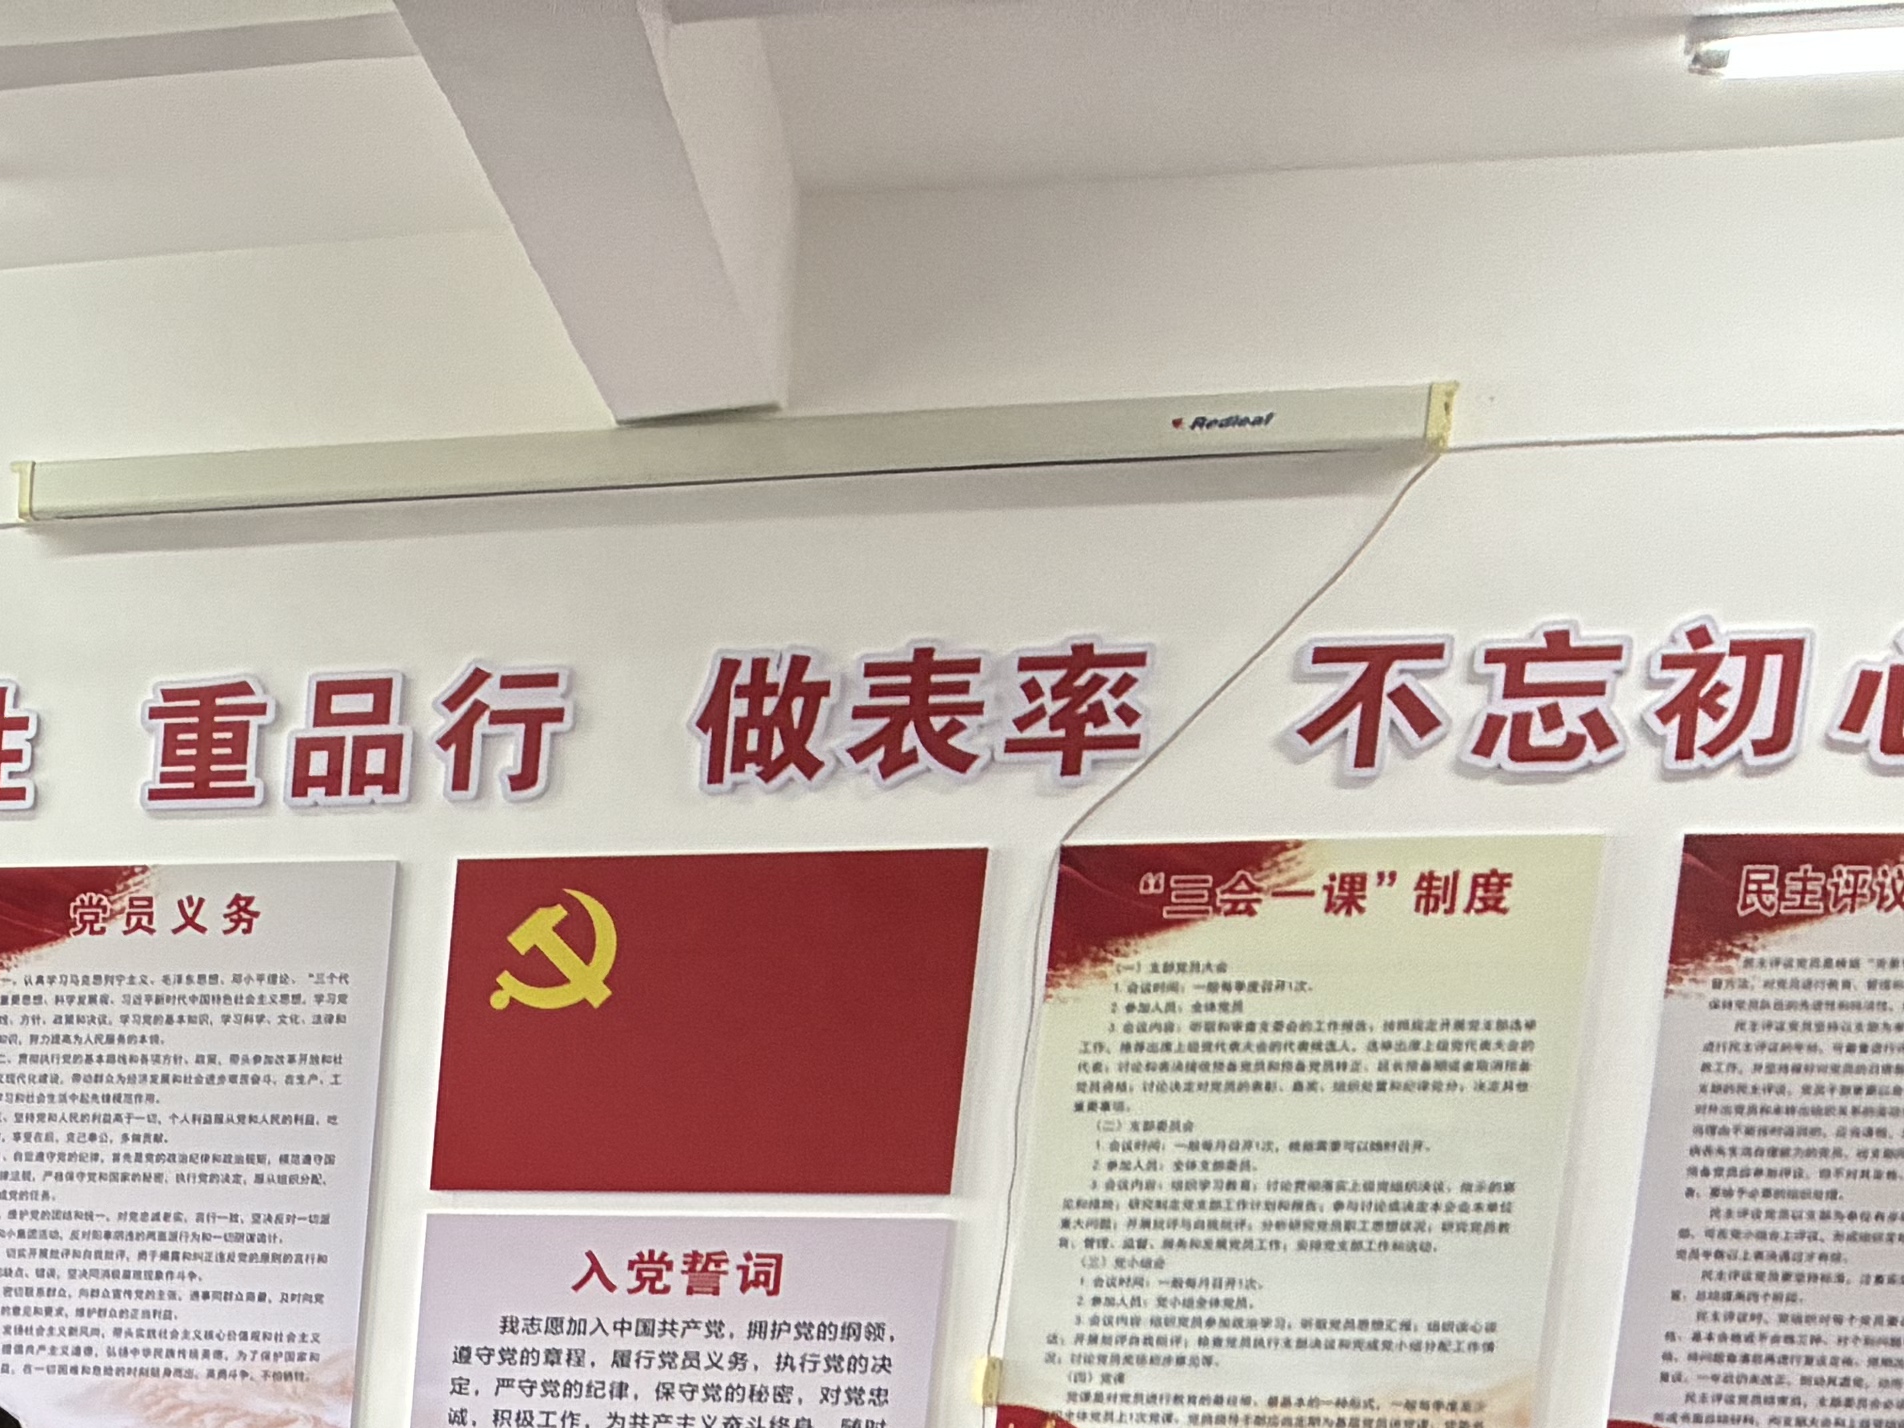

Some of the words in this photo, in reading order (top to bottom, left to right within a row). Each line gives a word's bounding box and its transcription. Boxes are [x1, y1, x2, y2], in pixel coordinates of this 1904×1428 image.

[147, 667, 565, 802] 重品行
[695, 643, 1147, 786] 做表率
[71, 893, 260, 936] 党员义务
[571, 1249, 783, 1296] 入党誓词
